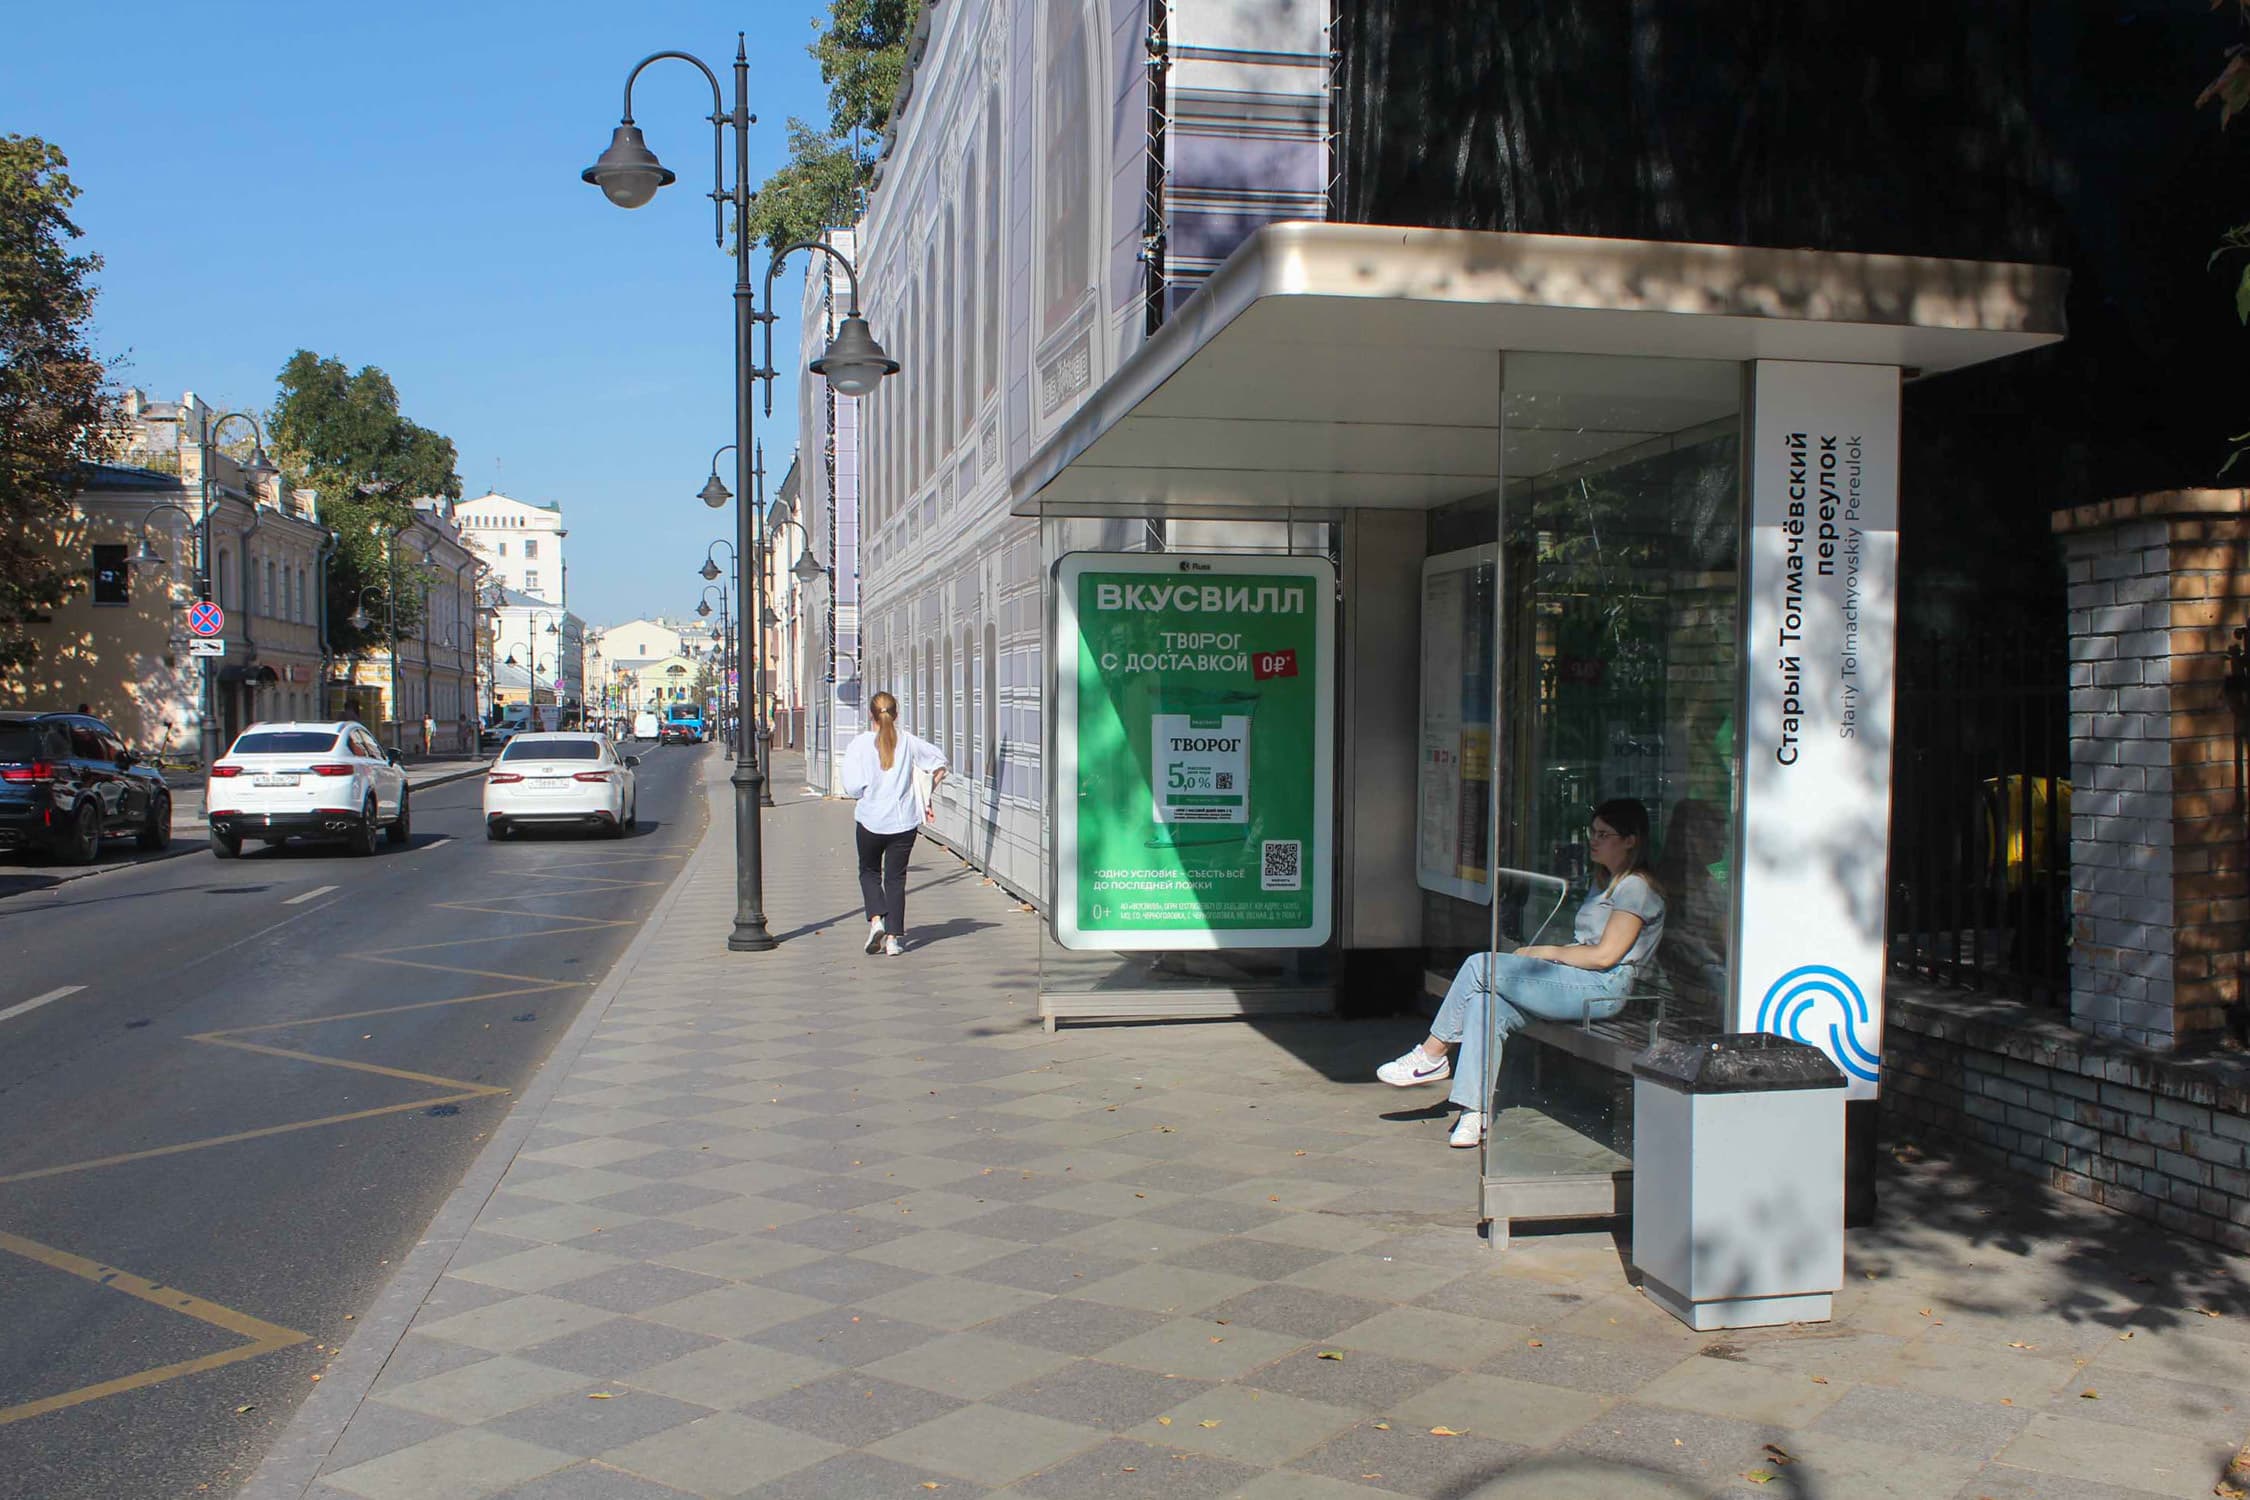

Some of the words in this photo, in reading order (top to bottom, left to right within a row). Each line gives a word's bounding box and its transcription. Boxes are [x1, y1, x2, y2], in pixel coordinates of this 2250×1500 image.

[1844, 435, 1862, 521] Pereulok
[1818, 435, 1840, 576] переулок
[1778, 432, 1807, 647] Толмачёвский
[1096, 583, 1304, 614] ВКУСВИЛЛ
[1841, 527, 1862, 680] Tolmachyovskiy
[1160, 631, 1242, 650] ТВОРОГ
[1100, 652, 1118, 671] С
[1125, 652, 1248, 673] ДОСТАВКОЙ
[1776, 656, 1803, 767] Старый
[1840, 685, 1859, 739] Stariy
[1170, 738, 1241, 752] ТВОРОГ
[1093, 881, 1110, 890] ДО
[1110, 880, 1174, 890] ПОСЛЕДНЕЙ
[1175, 881, 1213, 890] ЛОЖКИ
[1130, 869, 1178, 878] УСЛОВИЕ
[1187, 869, 1226, 878] СЪЕСТЬ
[1092, 904, 1112, 920] 0+
